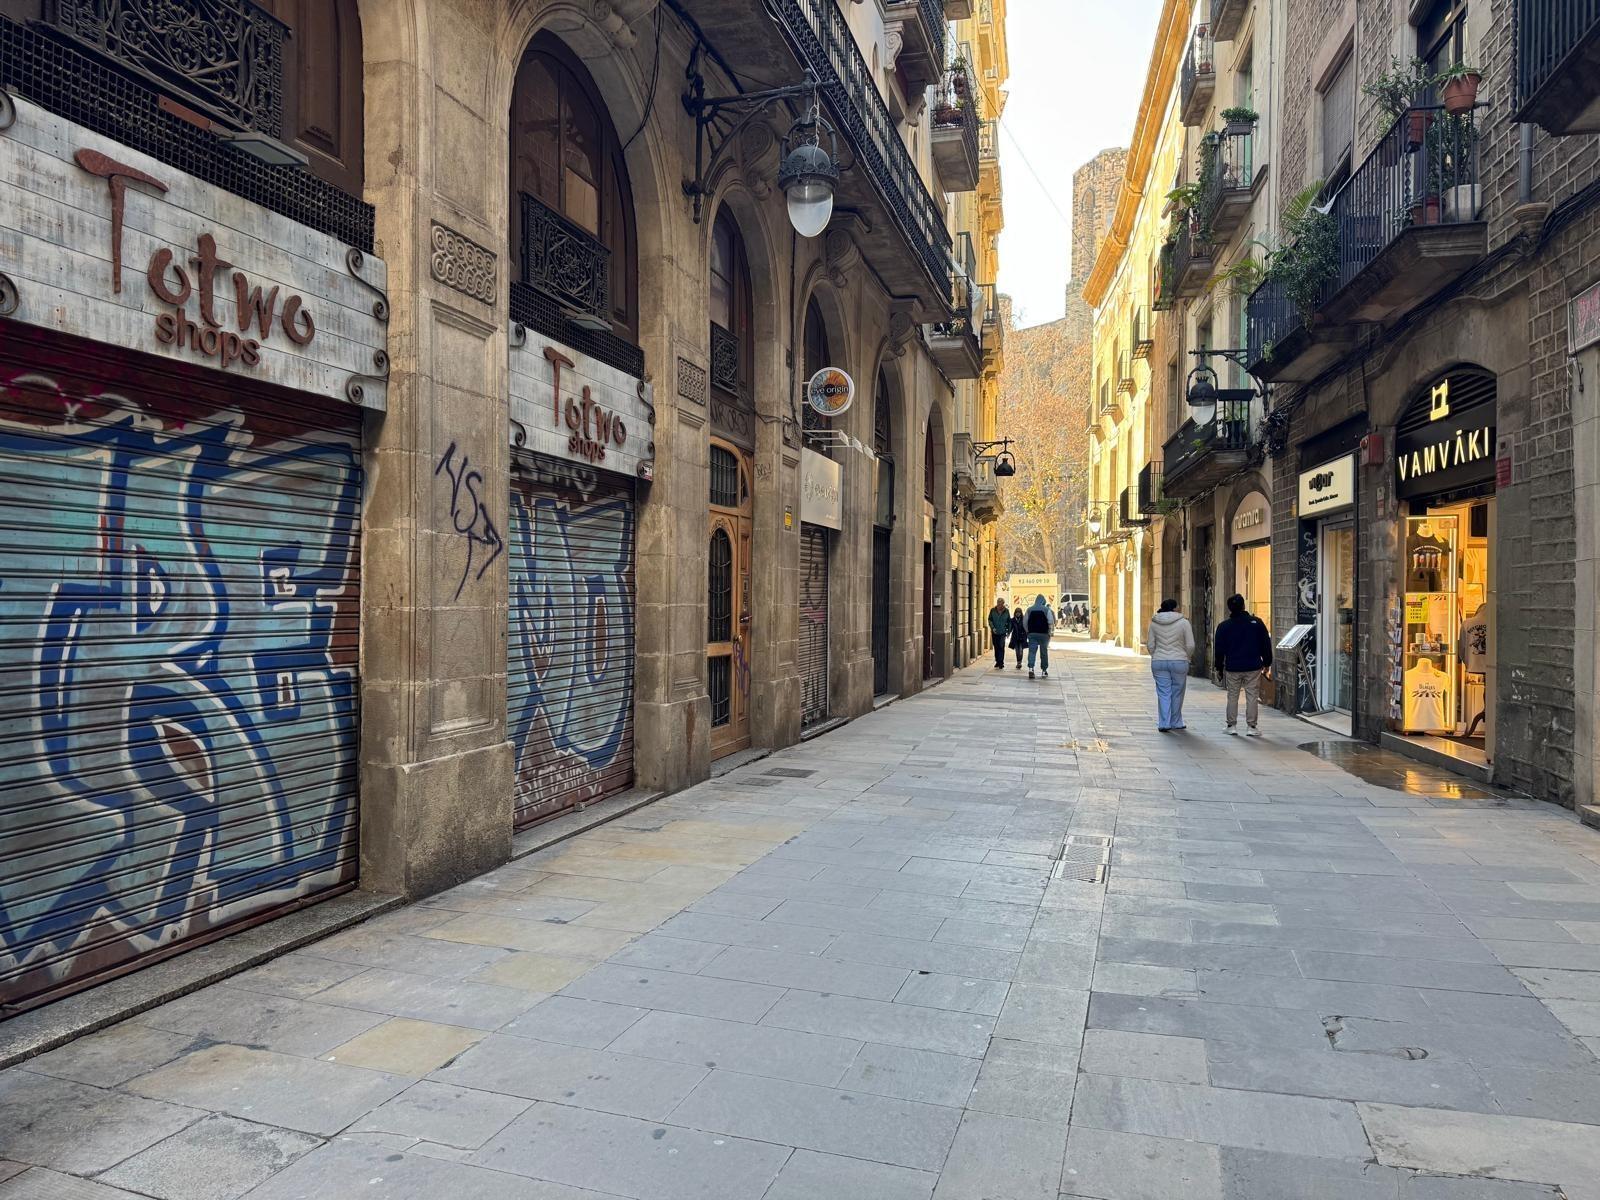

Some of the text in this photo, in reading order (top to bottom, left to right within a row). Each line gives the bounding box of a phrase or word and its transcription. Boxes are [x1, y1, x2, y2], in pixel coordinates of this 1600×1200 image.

[74, 148, 315, 345] Totwo
[155, 307, 260, 367] shops
[543, 346, 626, 445] Totwo
[826, 385, 849, 395] origin
[568, 431, 606, 463] shops
